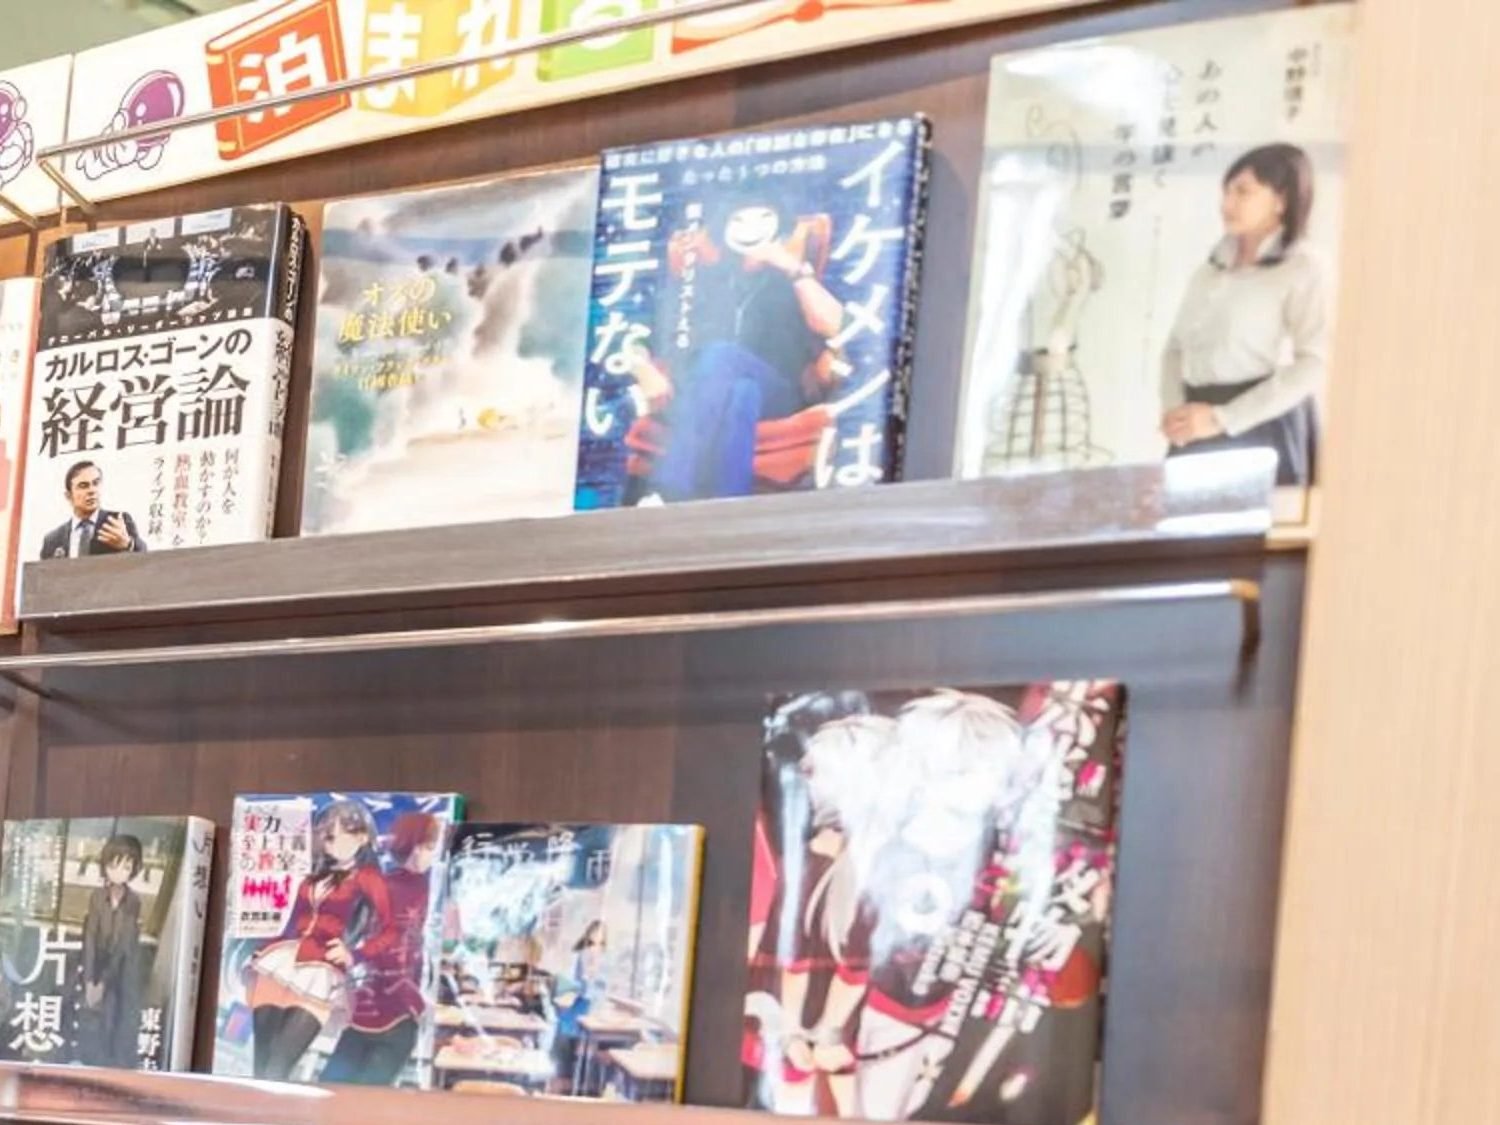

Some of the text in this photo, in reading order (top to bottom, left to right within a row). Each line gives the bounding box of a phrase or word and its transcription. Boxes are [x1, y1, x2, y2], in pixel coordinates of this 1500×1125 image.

[338, 306, 453, 344] 魔法使い
[584, 171, 663, 436] モテない
[815, 138, 906, 488] イケメンは
[44, 328, 254, 383] カルロス・ゴーンの
[38, 363, 251, 458] 経営論
[243, 814, 282, 833] 実力
[3, 926, 84, 1063] 片想
